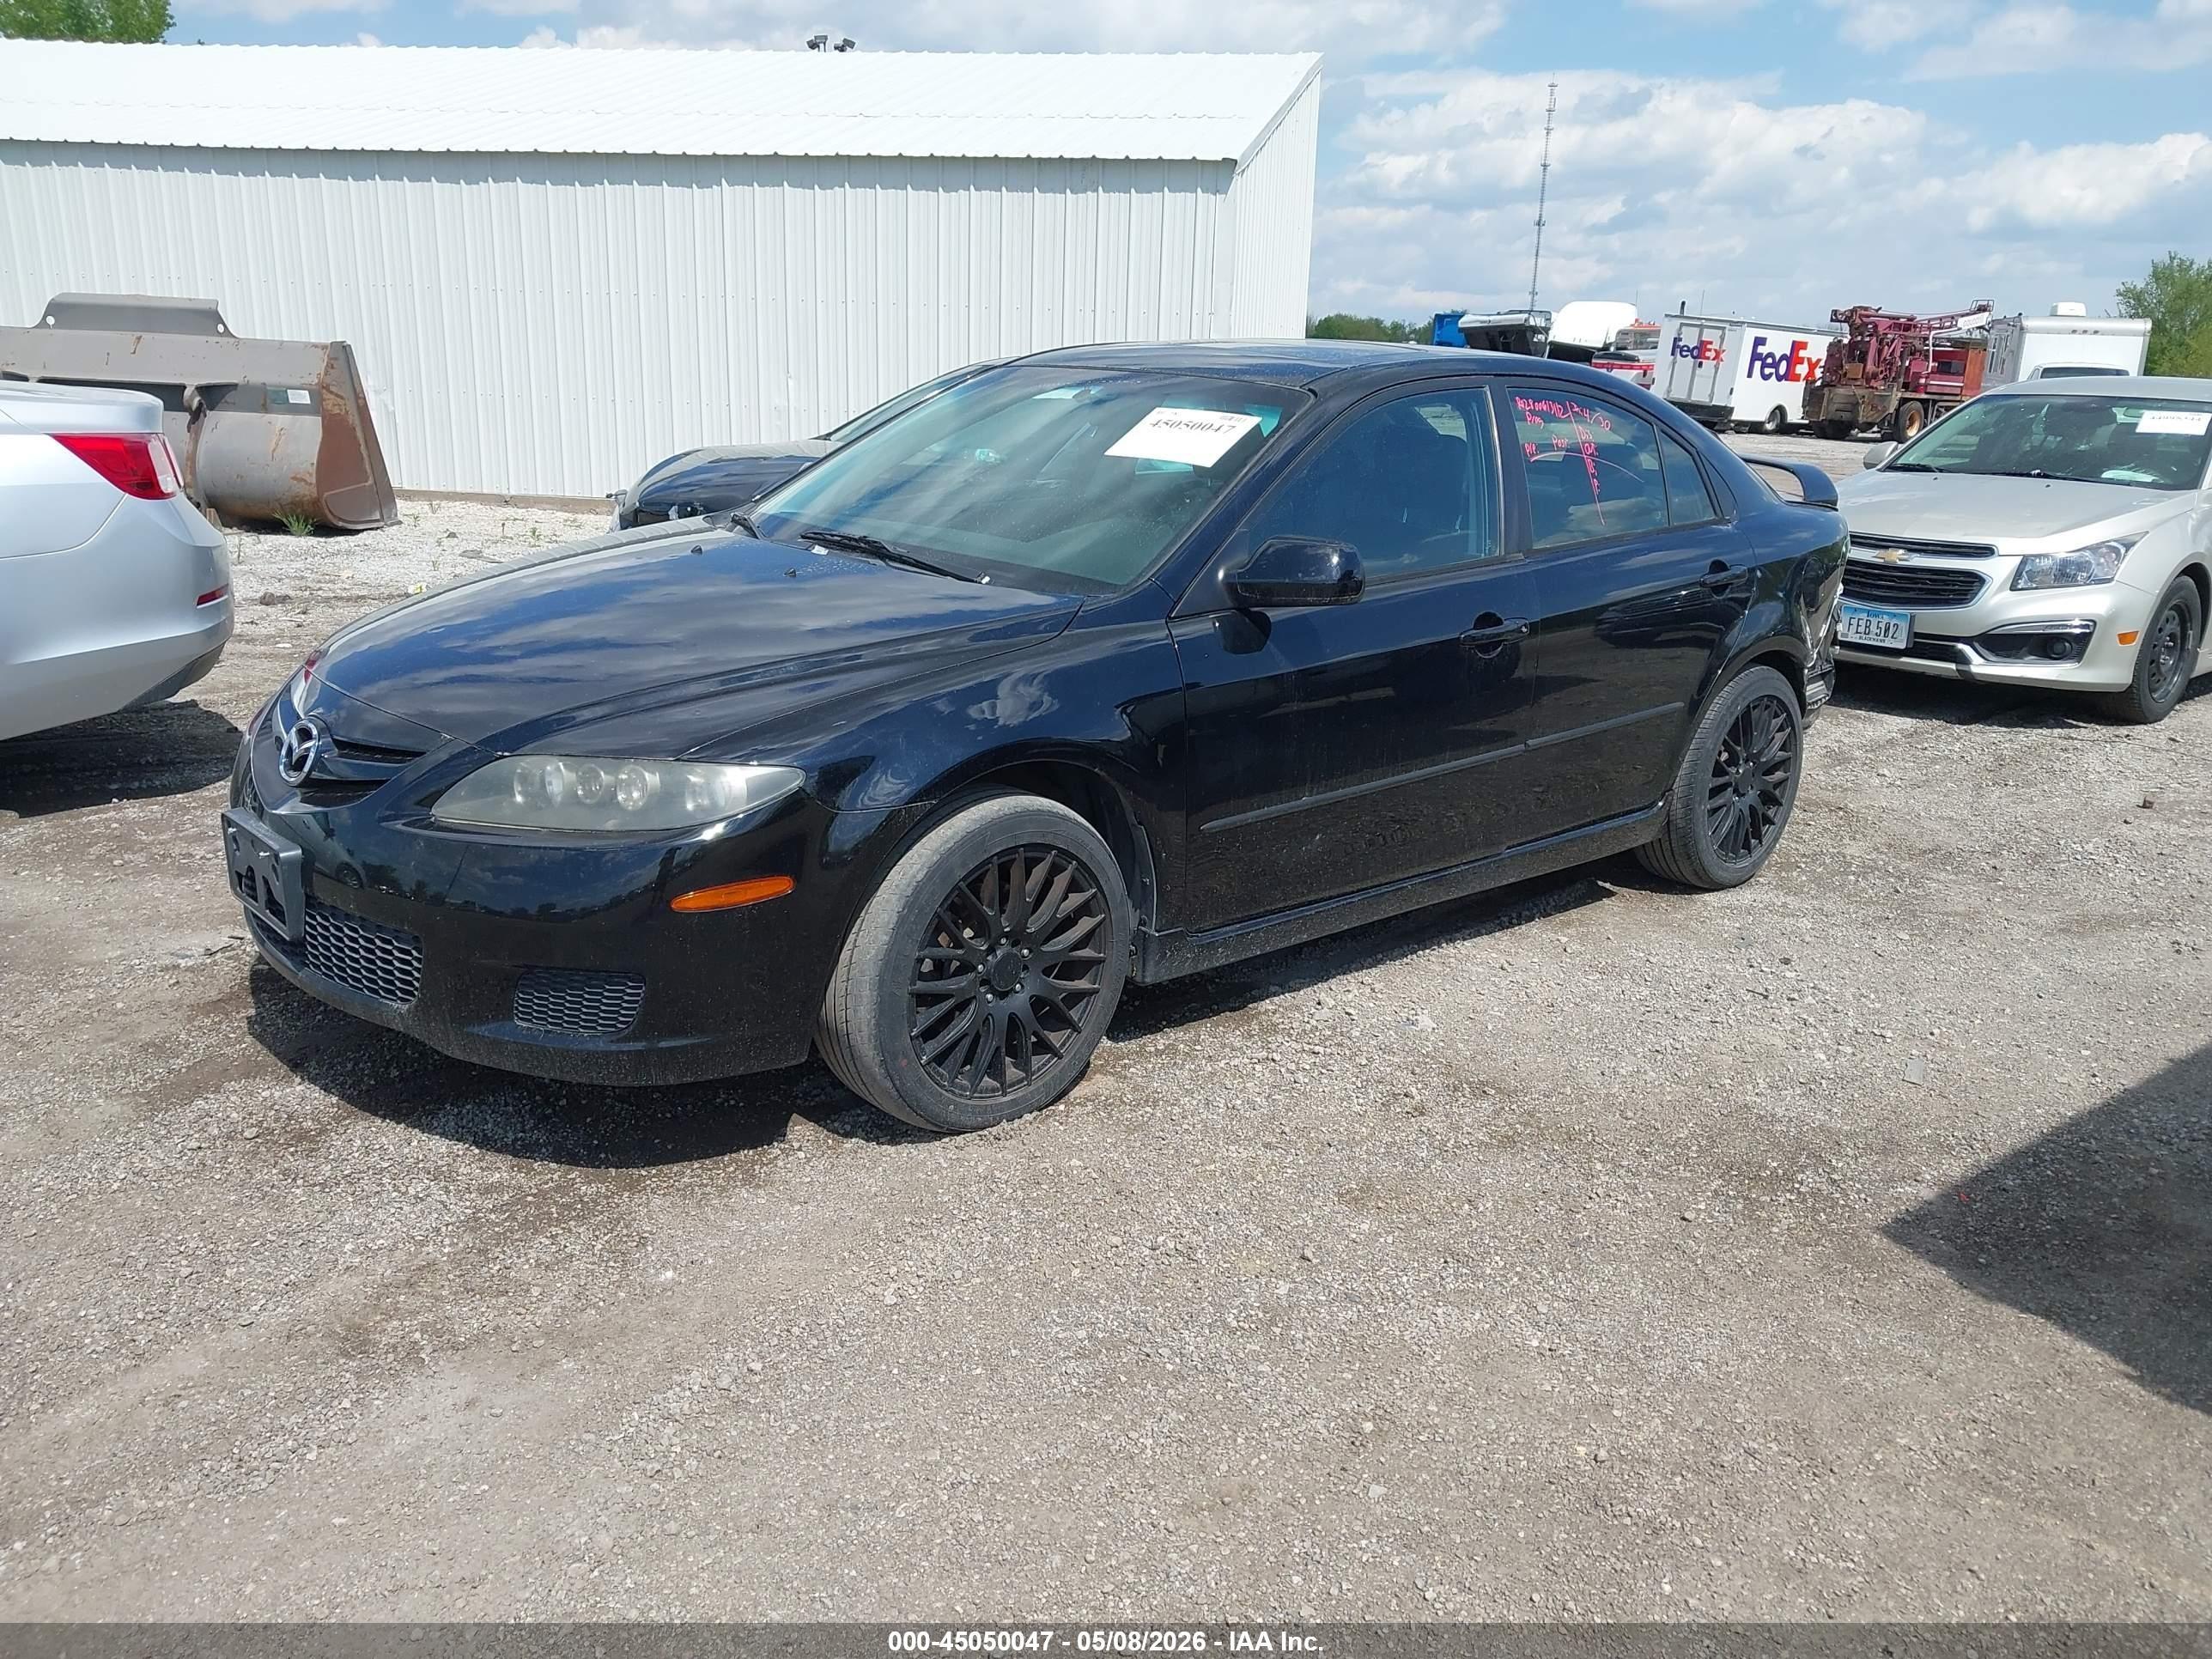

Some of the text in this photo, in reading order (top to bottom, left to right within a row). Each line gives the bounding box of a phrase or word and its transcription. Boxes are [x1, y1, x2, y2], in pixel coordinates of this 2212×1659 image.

[1670, 337, 1727, 362] FedEx
[1747, 336, 1822, 383] FedEx
[1149, 418, 1237, 434] 45050047
[1847, 617, 1899, 640] FEB 502
